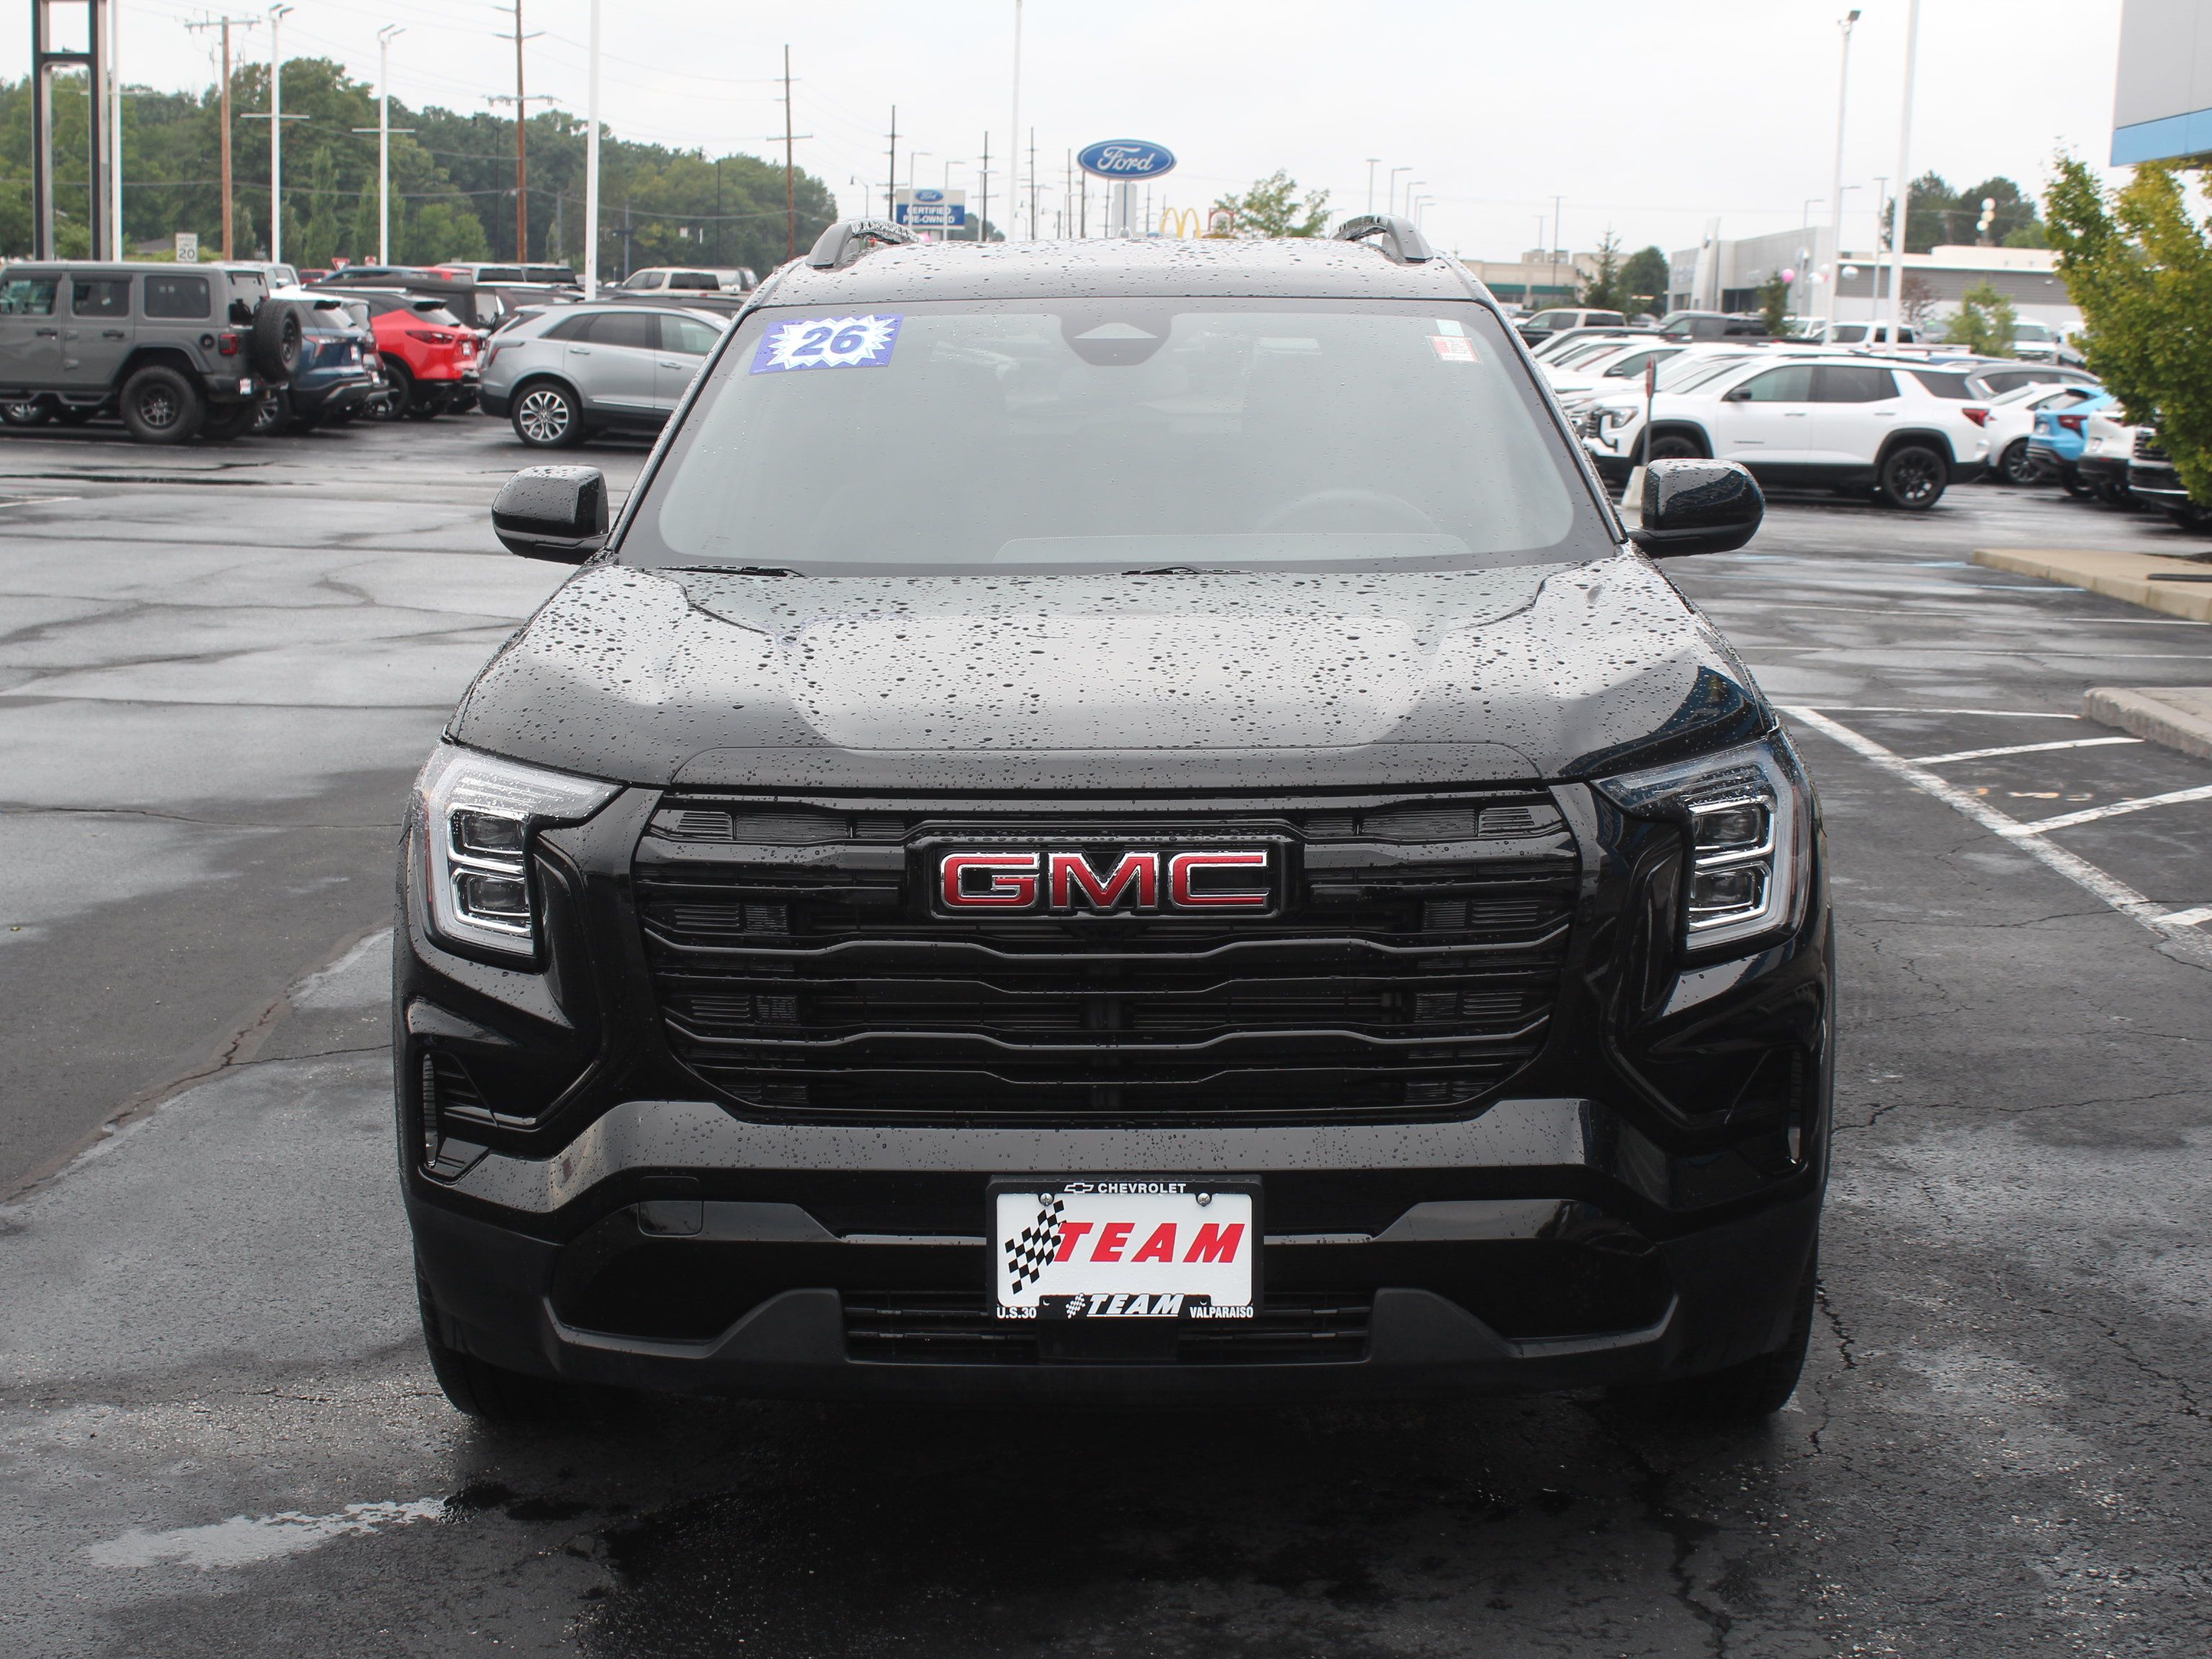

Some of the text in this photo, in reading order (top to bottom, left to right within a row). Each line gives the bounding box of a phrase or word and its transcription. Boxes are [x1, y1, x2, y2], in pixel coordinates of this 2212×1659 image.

[1097, 145, 1156, 171] Ford
[179, 248, 195, 259] 20
[791, 325, 870, 356] 26
[940, 852, 1269, 910] GMC
[1097, 1183, 1187, 1195] CHEVROLET
[1053, 1222, 1246, 1264] TEAM
[1087, 1294, 1184, 1316] TEAM
[1189, 1306, 1254, 1318] VALPARAISO
